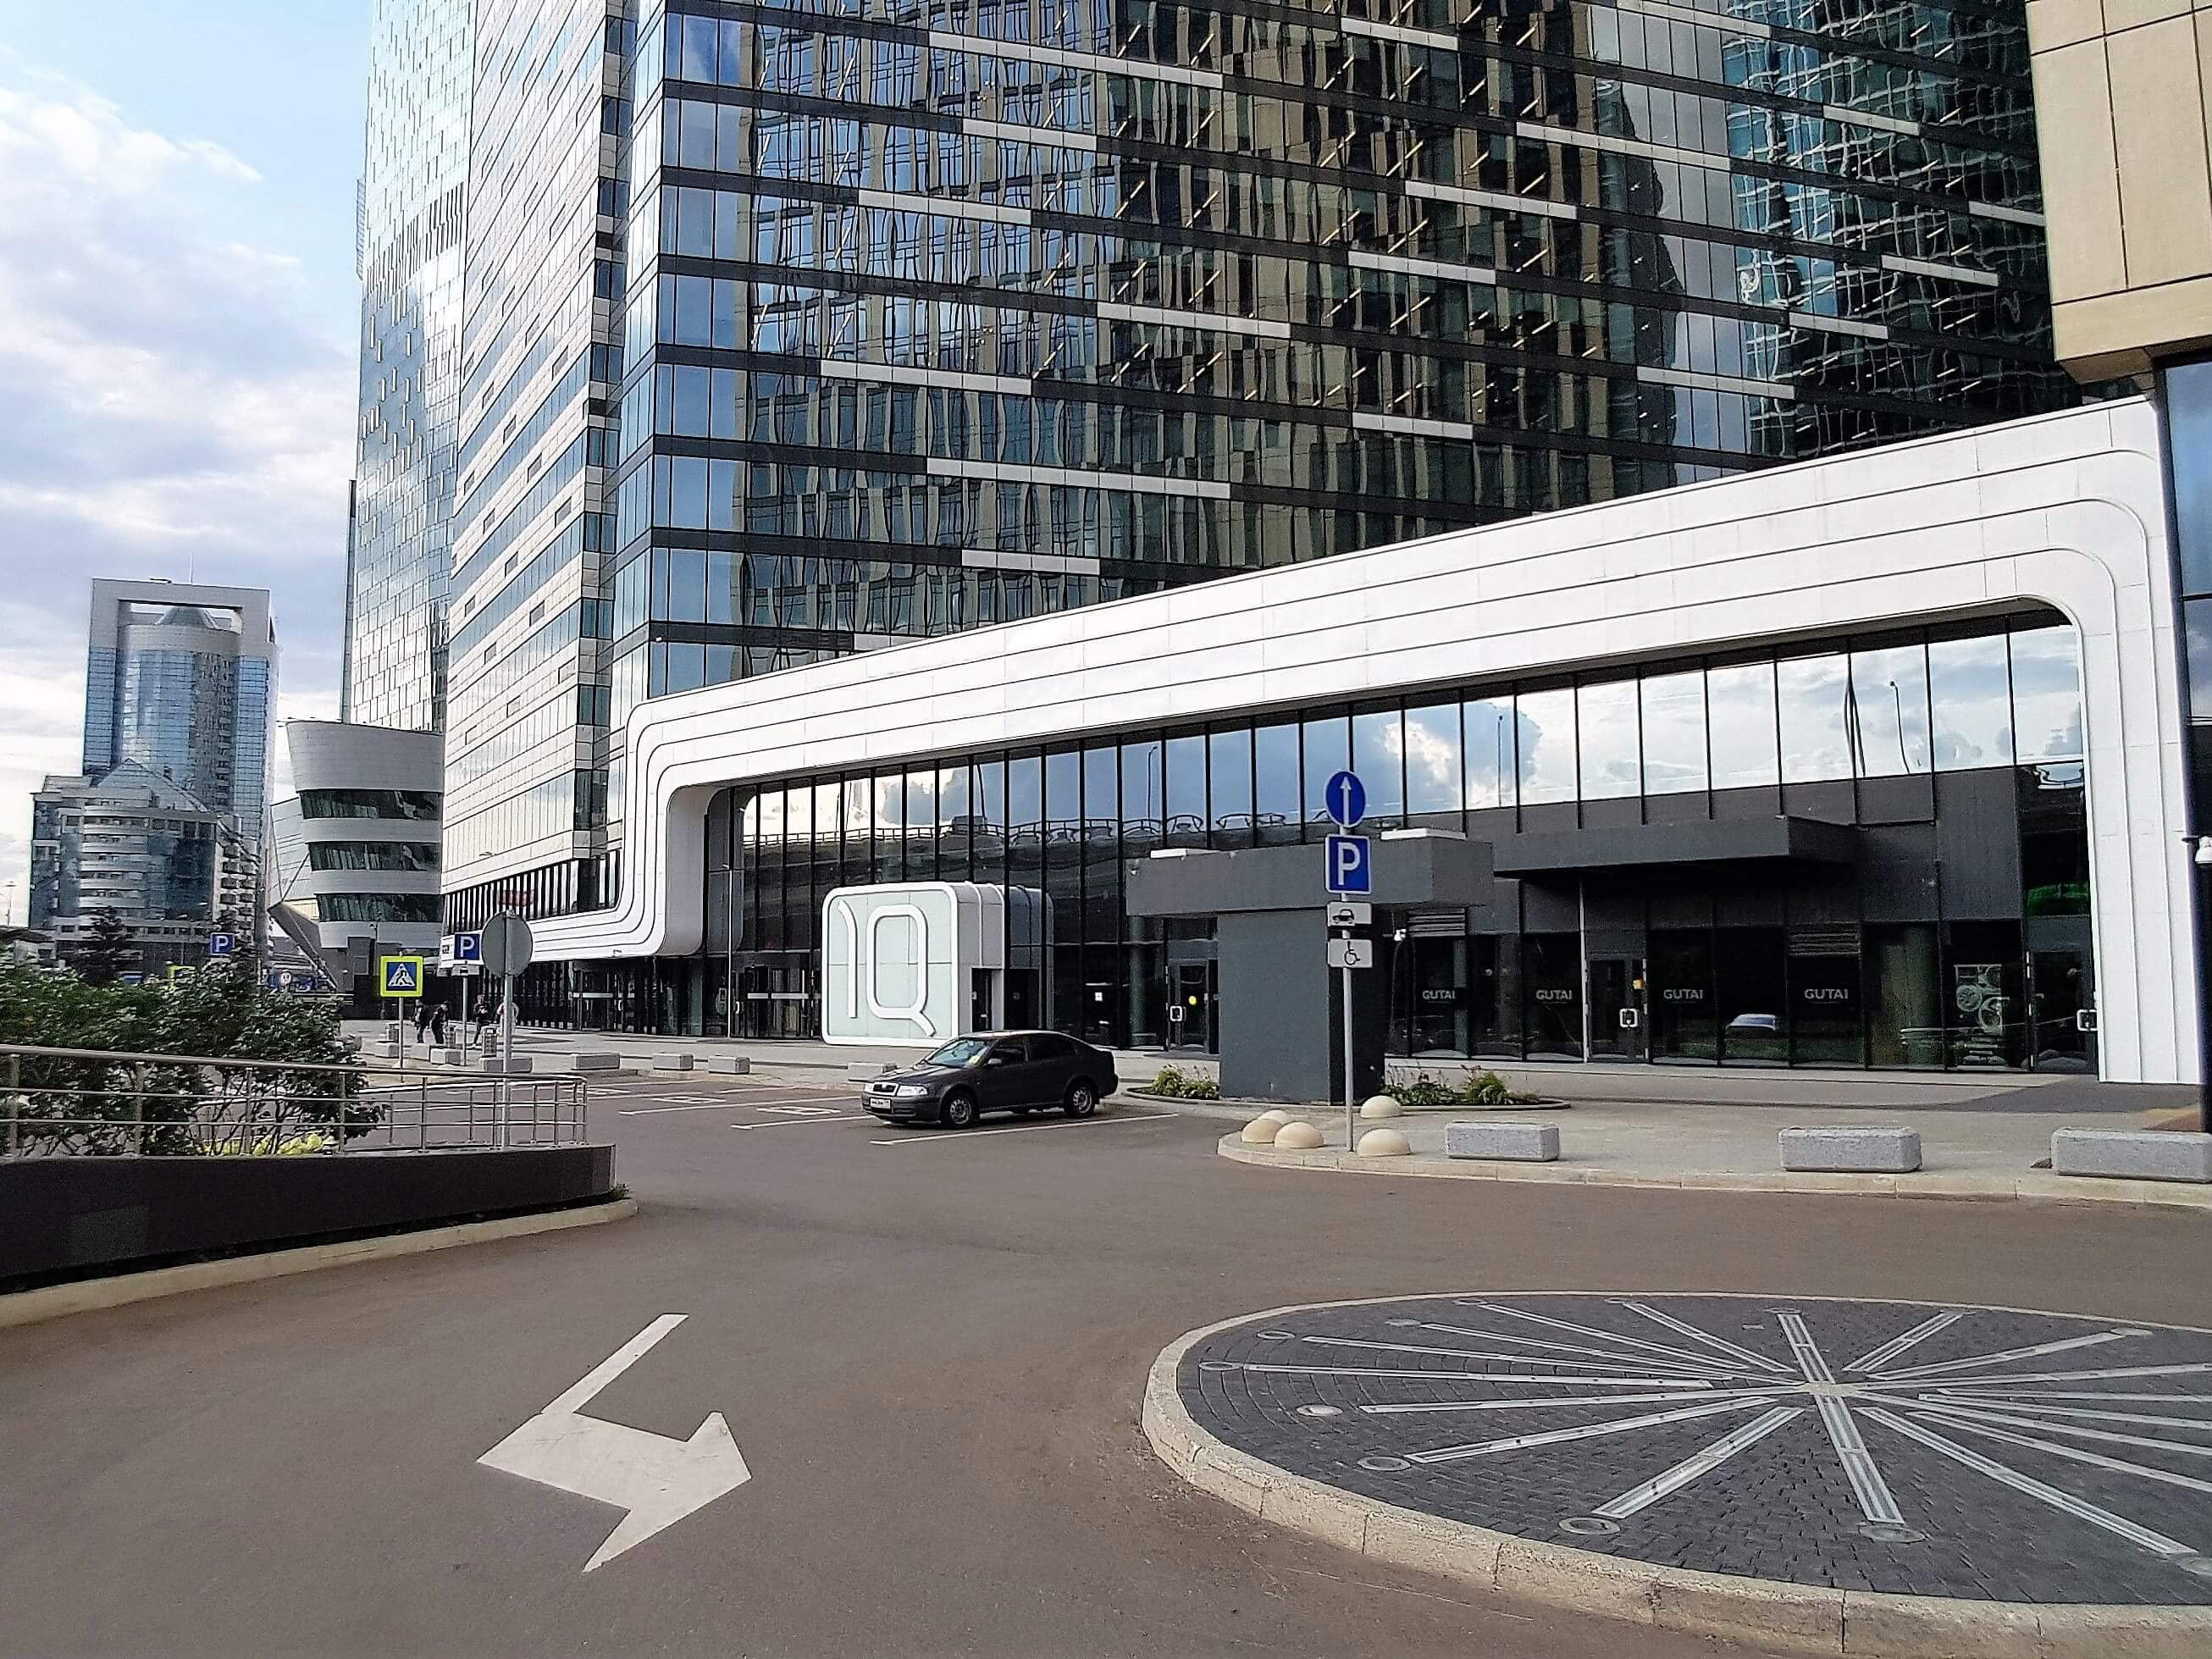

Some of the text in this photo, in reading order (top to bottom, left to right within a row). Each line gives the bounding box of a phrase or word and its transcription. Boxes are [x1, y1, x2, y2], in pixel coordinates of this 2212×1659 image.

[1337, 842, 1361, 886] P
[215, 935, 229, 953] P
[460, 936, 475, 958] P
[1804, 988, 1849, 999] GUTAI
